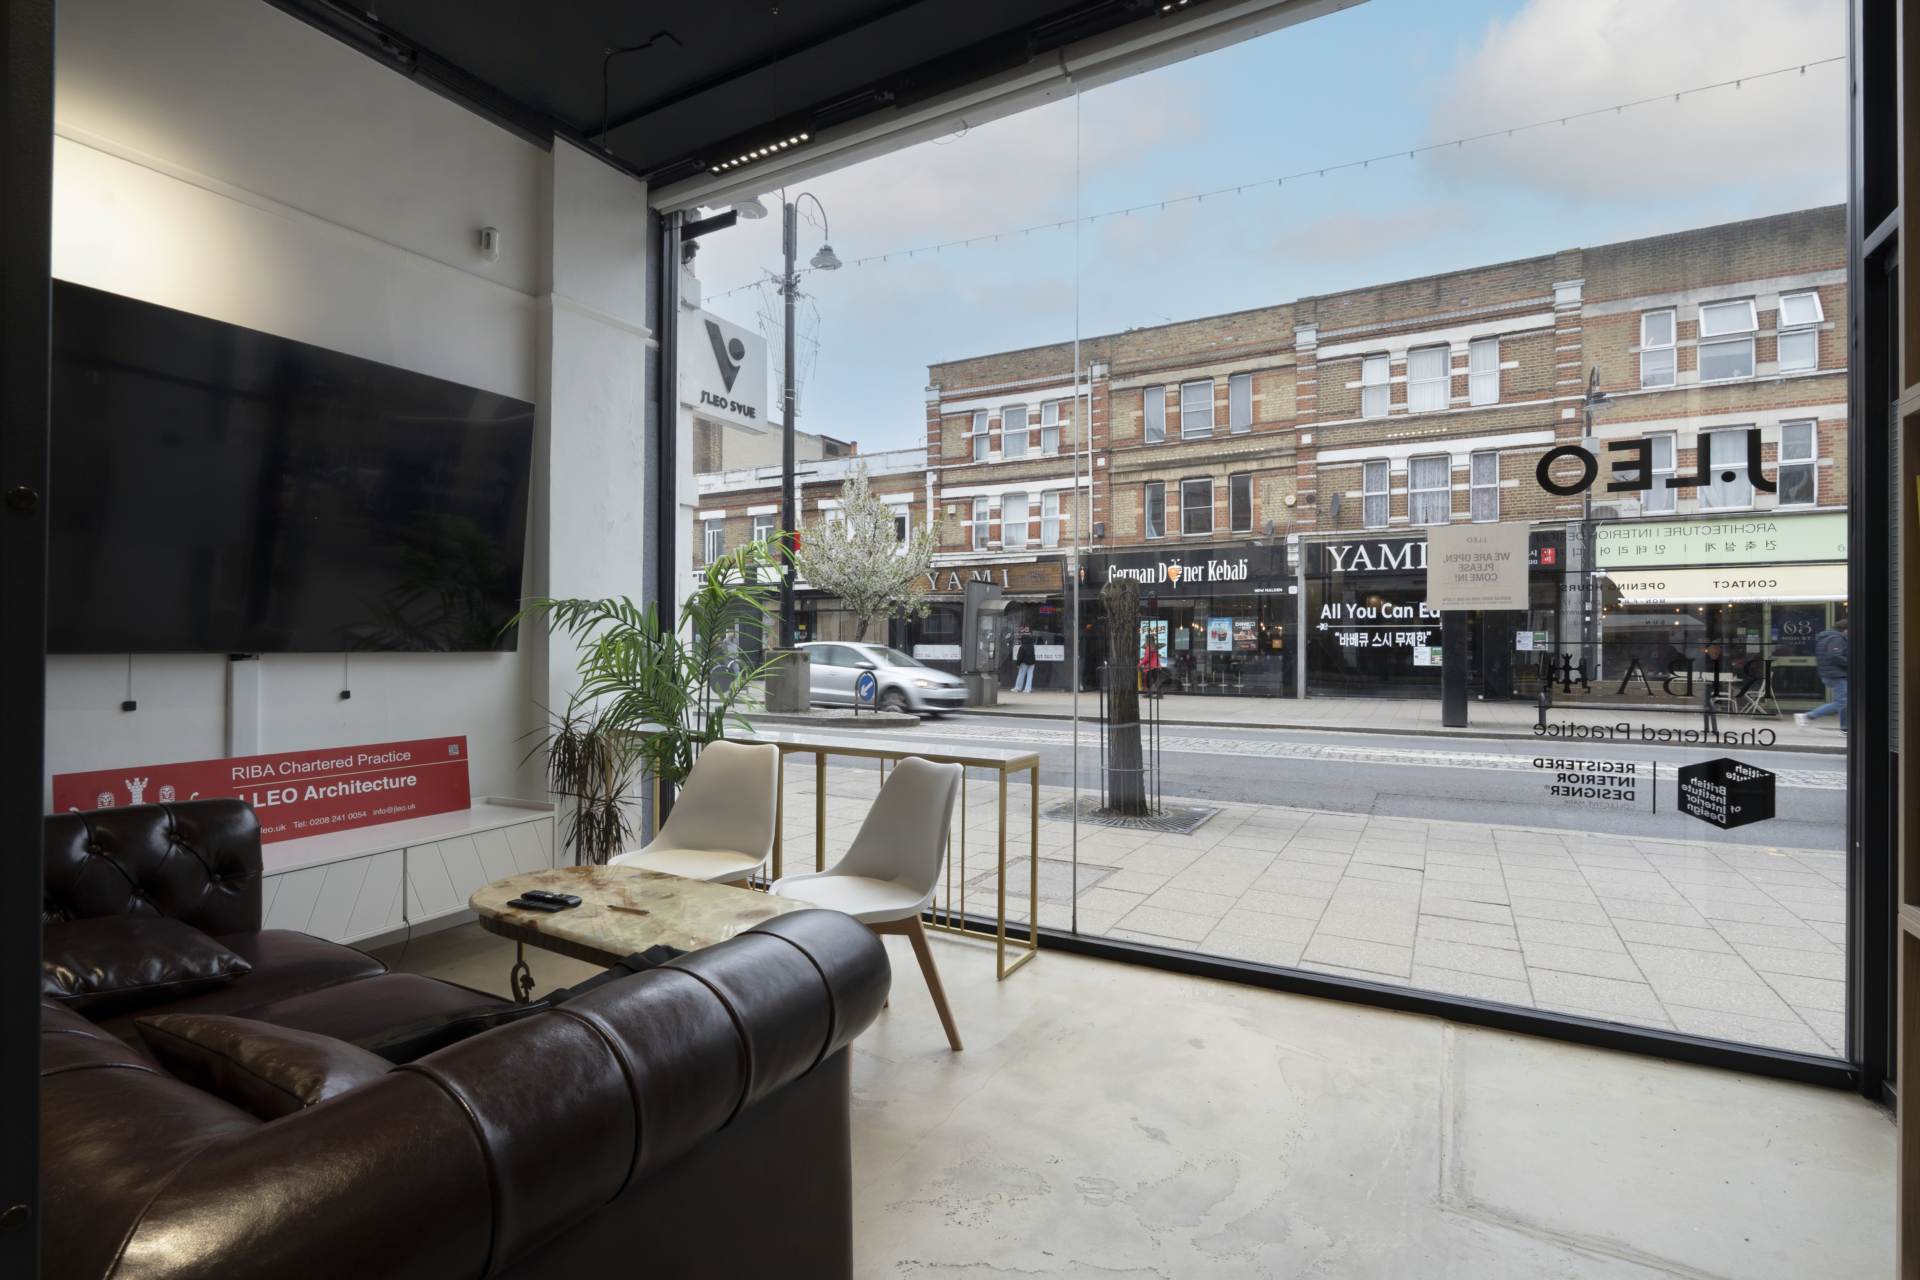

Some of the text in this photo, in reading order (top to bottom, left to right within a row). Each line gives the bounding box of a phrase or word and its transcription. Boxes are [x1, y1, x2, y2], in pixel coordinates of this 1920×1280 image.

[1326, 540, 1428, 573] YAMI
[1321, 602, 1441, 619] All You Can Ea
[1372, 632, 1392, 647] 스시
[232, 750, 411, 780] RIBA Chartered Practice
[304, 775, 417, 800] Architecture
[310, 817, 330, 826] 0208
[331, 814, 346, 823] 241
